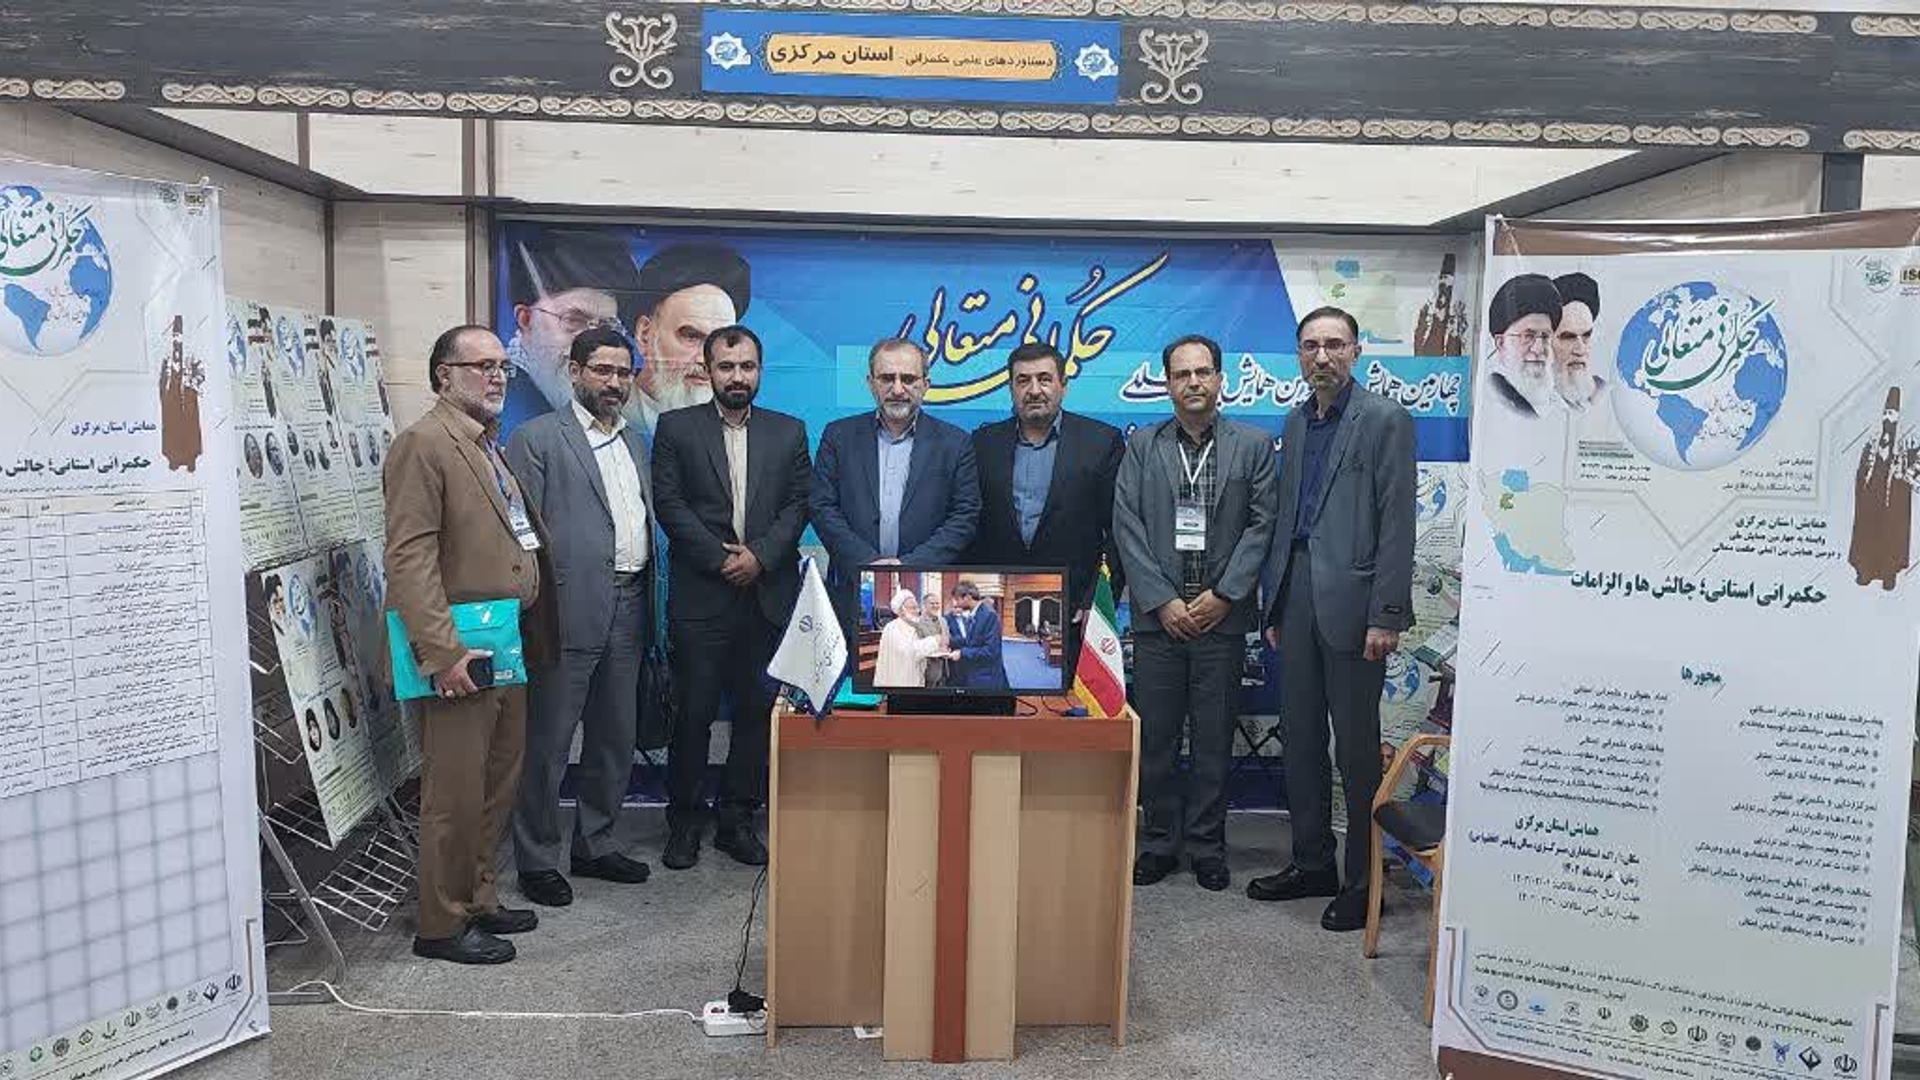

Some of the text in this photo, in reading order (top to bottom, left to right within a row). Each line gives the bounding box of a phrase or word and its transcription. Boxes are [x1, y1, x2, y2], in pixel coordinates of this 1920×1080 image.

[770, 43, 836, 65] مرکزی
[842, 46, 893, 65] استان
[905, 53, 949, 66] حکمرانی
[952, 54, 981, 67] علمی
[985, 54, 1053, 67] دستاوردهای
[71, 422, 100, 436] مرکزی
[101, 420, 126, 435] استان
[5, 459, 45, 477] چالش
[97, 455, 152, 474] حکمرانی
[1735, 515, 1766, 529] مرکزی
[1768, 517, 1793, 529] استان
[1571, 571, 1622, 595] الزامات
[1625, 581, 1632, 597] و
[1635, 574, 1649, 592] ها
[1652, 575, 1696, 600] چالش
[1757, 583, 1827, 608] حکمرانی
[1515, 815, 1599, 837] همایش استان مرکزی
